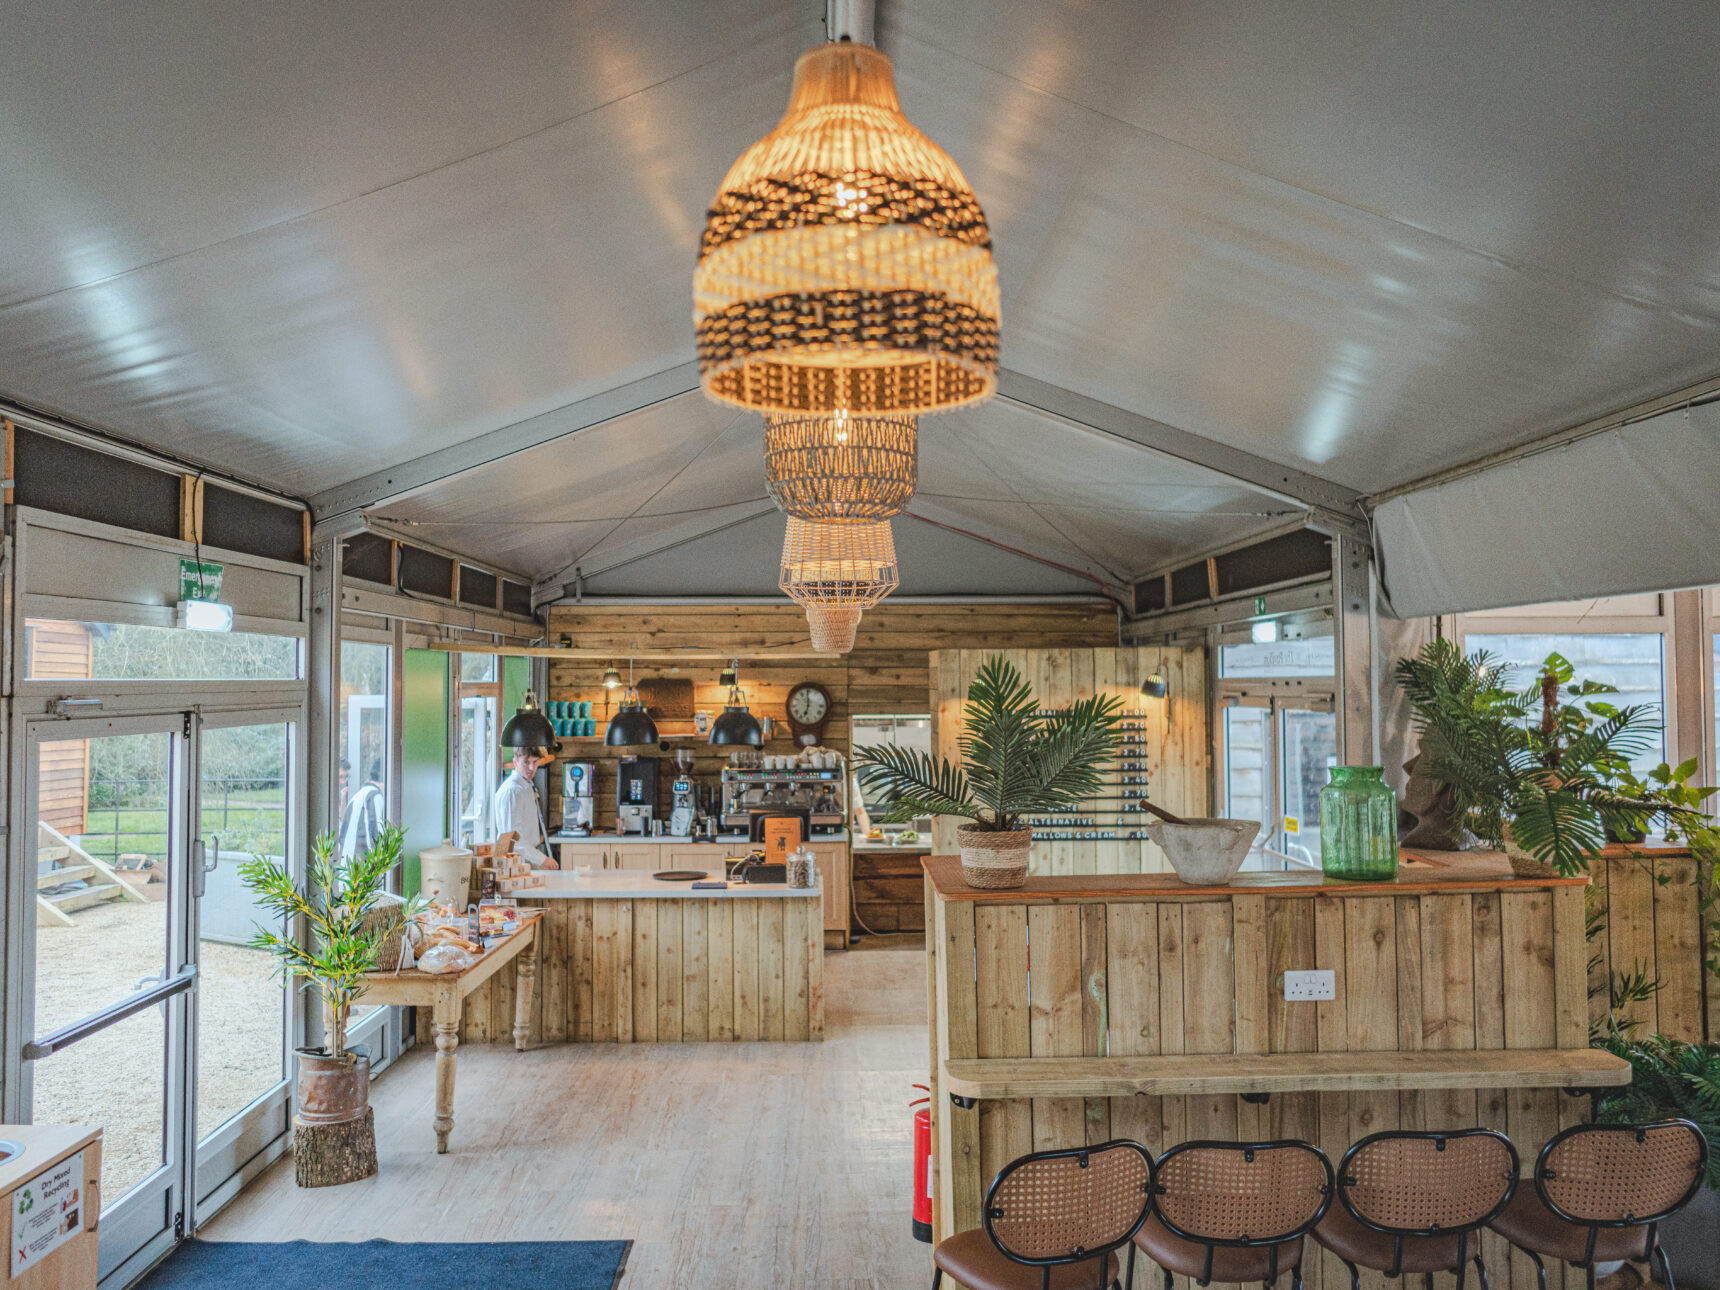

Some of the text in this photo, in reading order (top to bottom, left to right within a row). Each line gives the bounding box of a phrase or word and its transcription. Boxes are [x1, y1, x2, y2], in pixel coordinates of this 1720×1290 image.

[193, 587, 206, 599] Ext
[42, 1167, 71, 1190] Dry Mixed
[43, 1179, 70, 1200] Recycling
